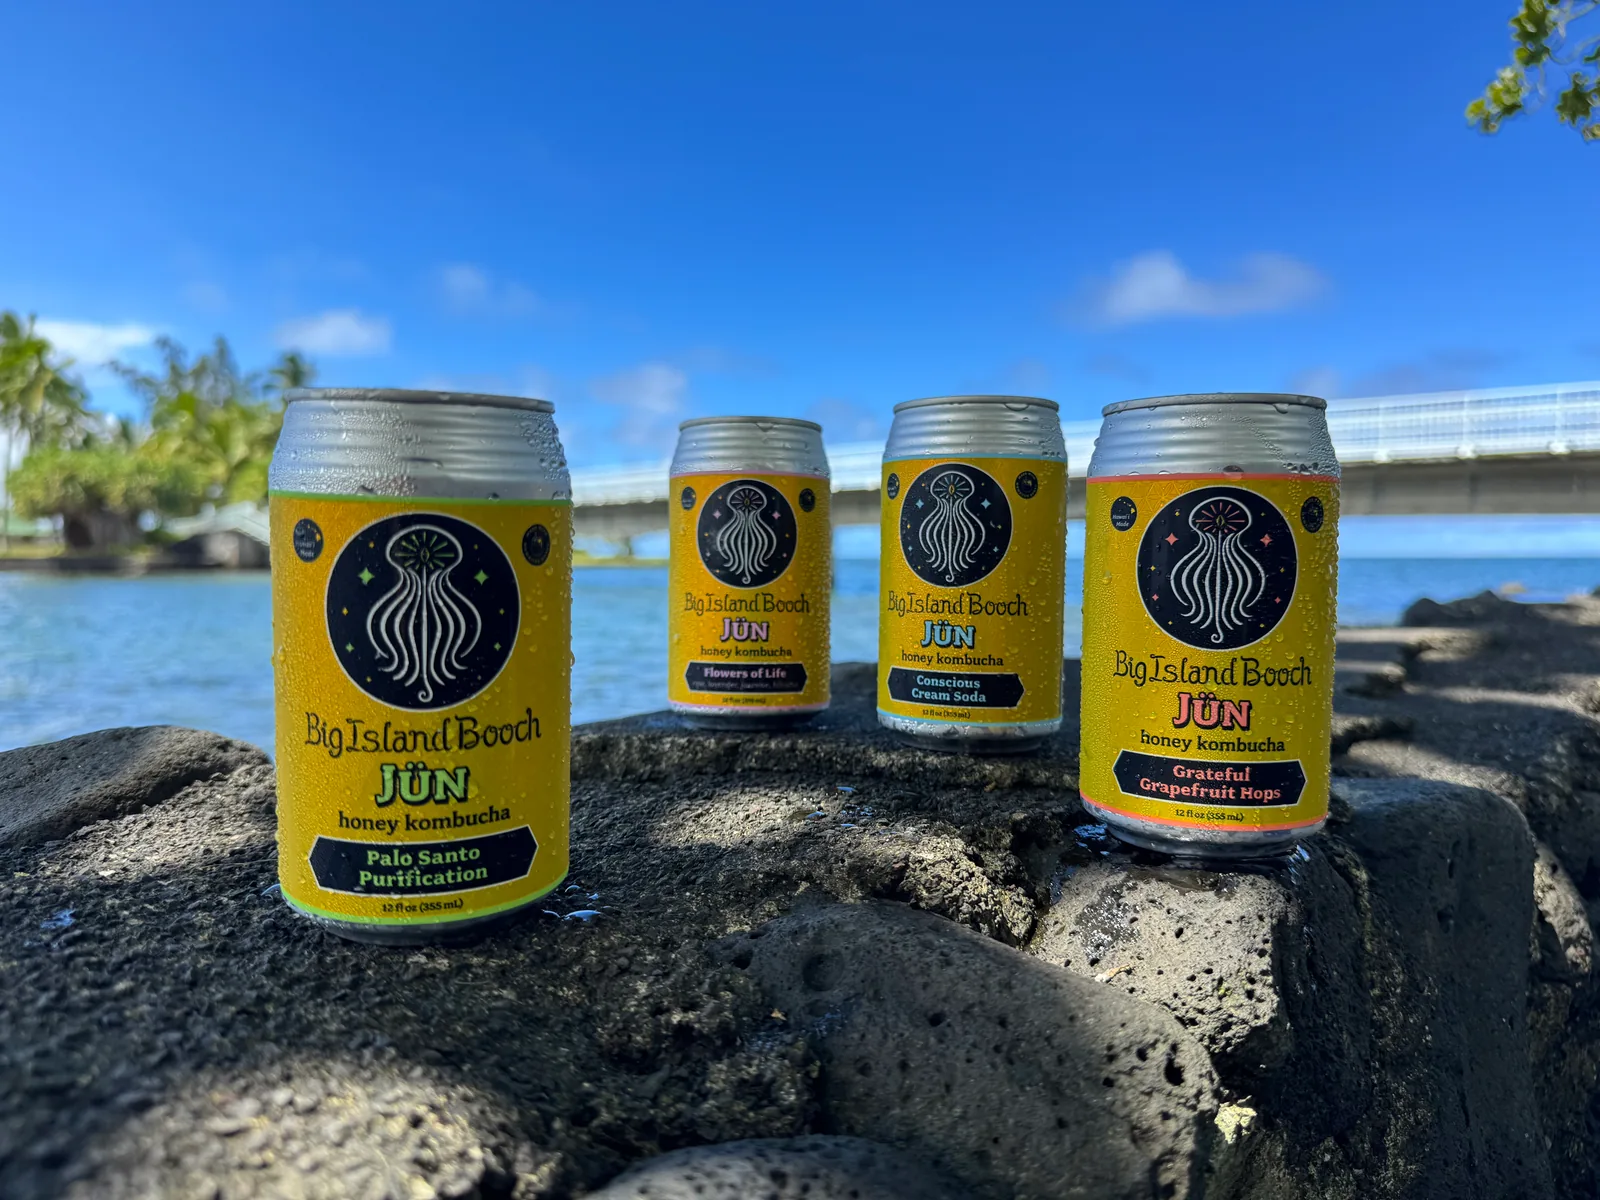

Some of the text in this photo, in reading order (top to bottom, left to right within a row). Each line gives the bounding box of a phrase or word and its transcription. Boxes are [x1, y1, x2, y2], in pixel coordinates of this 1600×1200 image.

[684, 591, 809, 616] Big Island Booch
[888, 591, 1028, 617] Big Island Booch
[720, 617, 769, 642] JÜN
[920, 620, 976, 649] JÜN
[701, 646, 792, 658] honey kombucha
[901, 650, 1004, 666] honey kombucha
[704, 667, 787, 678] Flowers of Life
[1113, 650, 1312, 687] Big Island Booch
[916, 675, 980, 689] Conscious
[911, 688, 986, 702] Cream Soda
[1172, 692, 1252, 731] JÜN
[304, 708, 541, 758] Big Island Booch
[1141, 730, 1285, 753] honey kombucha
[375, 761, 470, 807] JÜN
[1173, 765, 1250, 782] Grateful
[1140, 778, 1281, 803] Grapefruit Hops
[338, 806, 510, 835] honey kombucha
[1175, 809, 1185, 817] 12
[1186, 809, 1193, 818] fl
[1206, 811, 1226, 820] (355
[1227, 812, 1244, 822] mL)
[366, 848, 480, 867] Palo Santo
[359, 866, 488, 888] Purification
[383, 898, 464, 913] 12 fl oz (355 mL)
